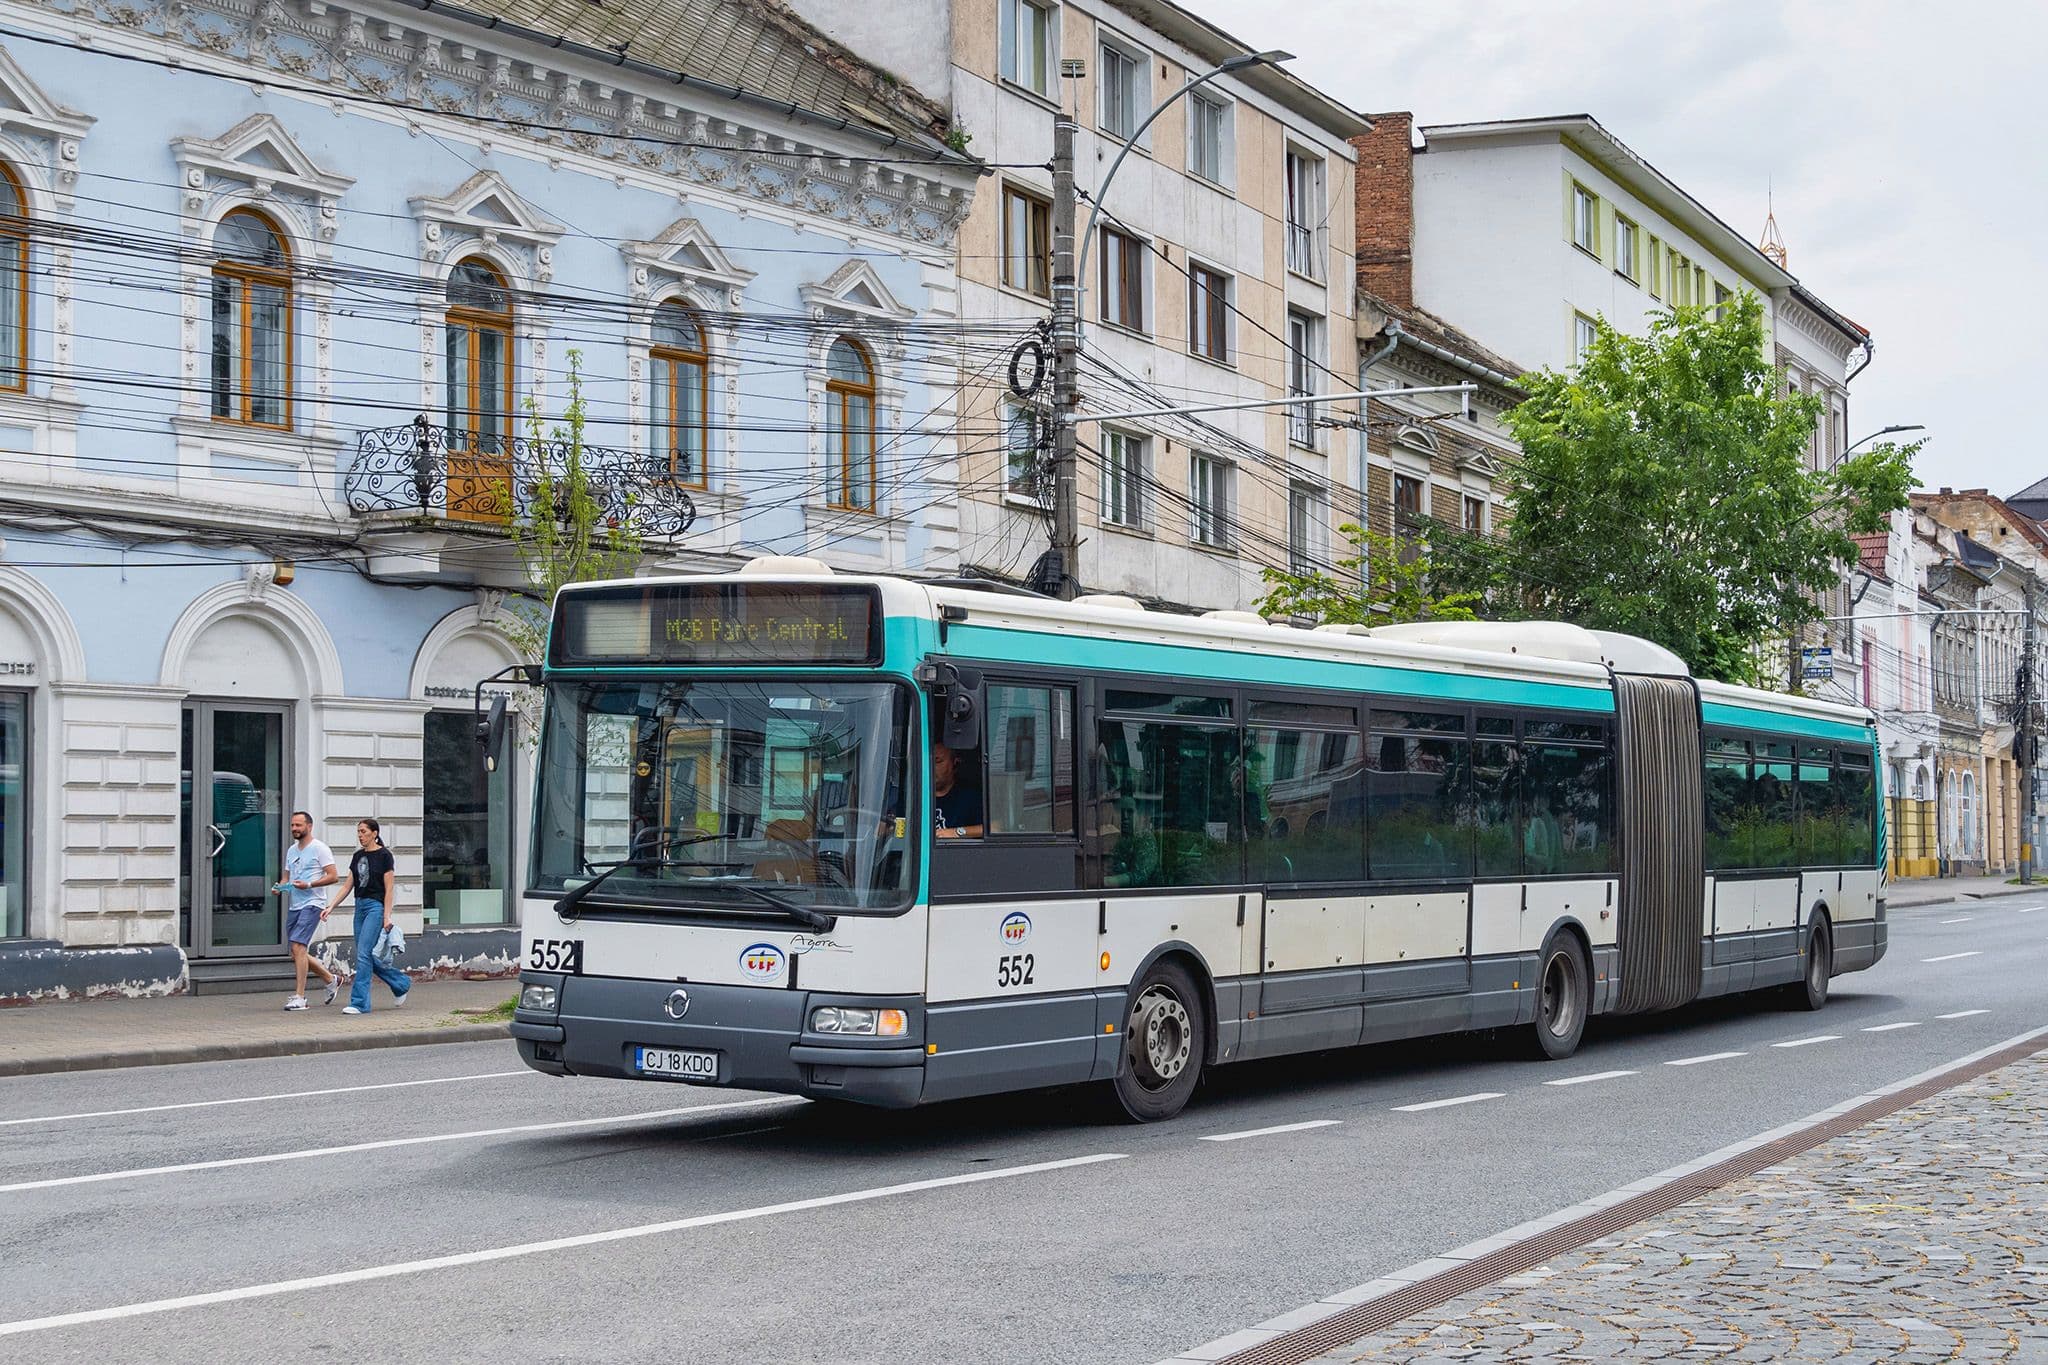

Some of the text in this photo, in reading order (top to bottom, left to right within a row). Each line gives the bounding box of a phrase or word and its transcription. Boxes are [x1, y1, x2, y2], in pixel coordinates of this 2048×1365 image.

[711, 618, 759, 641] Parc
[766, 616, 848, 641] Central
[530, 939, 576, 970] 552
[789, 934, 850, 955] Agora
[998, 953, 1034, 987] 552
[646, 1051, 713, 1073] CJ 18 KDO
